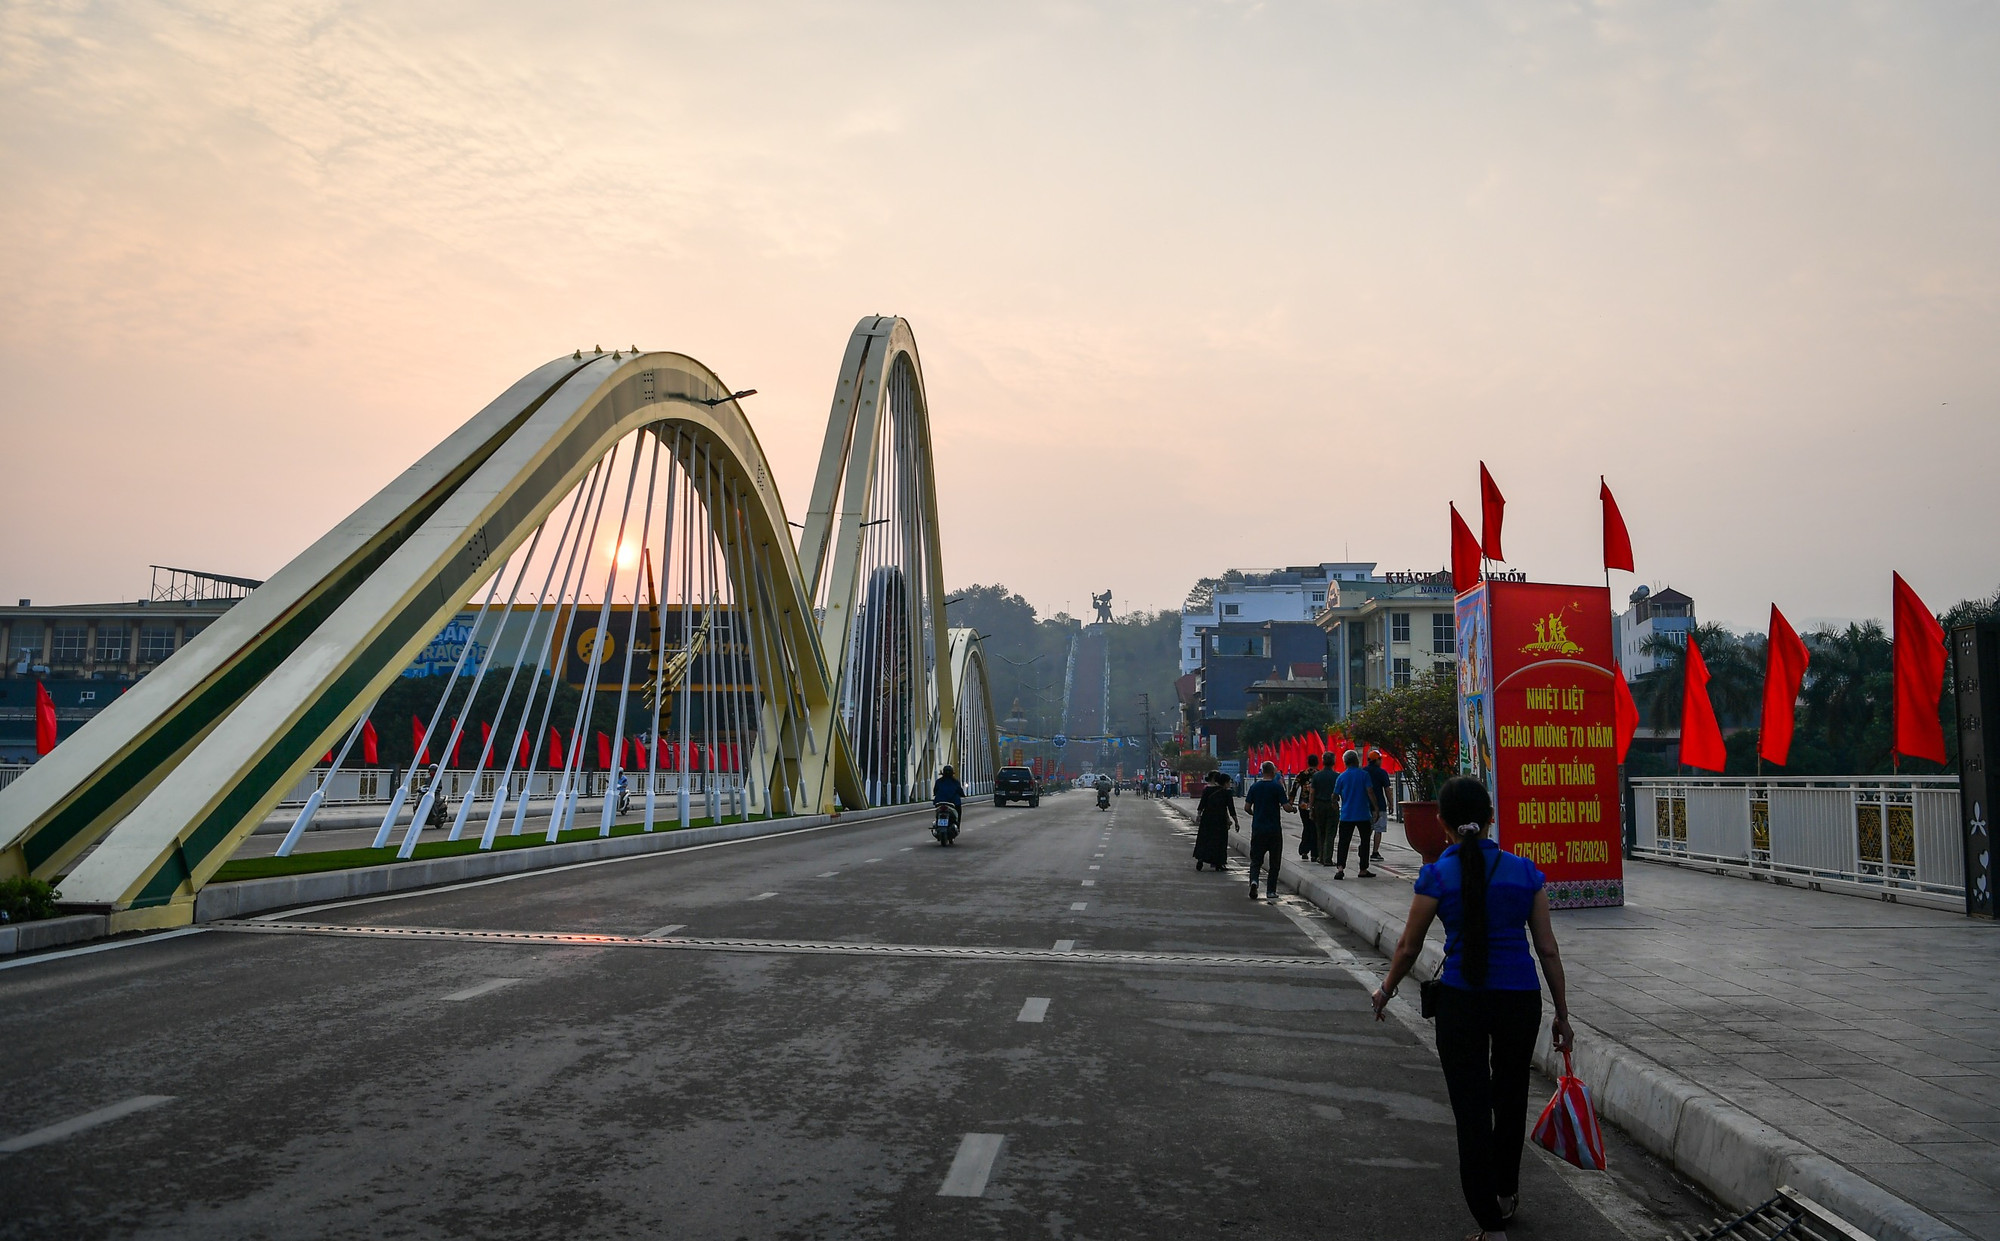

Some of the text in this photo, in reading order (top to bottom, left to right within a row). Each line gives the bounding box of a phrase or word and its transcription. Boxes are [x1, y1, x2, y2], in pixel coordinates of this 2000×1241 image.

[1385, 569, 1432, 584] KHÁCH
[1526, 683, 1584, 715] NHIỆT LIỆT
[1499, 721, 1613, 748] CHÀO MỪNG 70 NĂM
[1521, 756, 1556, 786] CHIẾN
[1558, 755, 1596, 786] THẮNG
[1518, 793, 1601, 829] ĐIỆN BIÊN PHỦ
[1514, 842, 1558, 864] (7/5/1954
[1565, 840, 1609, 864] 7/5/2024)
